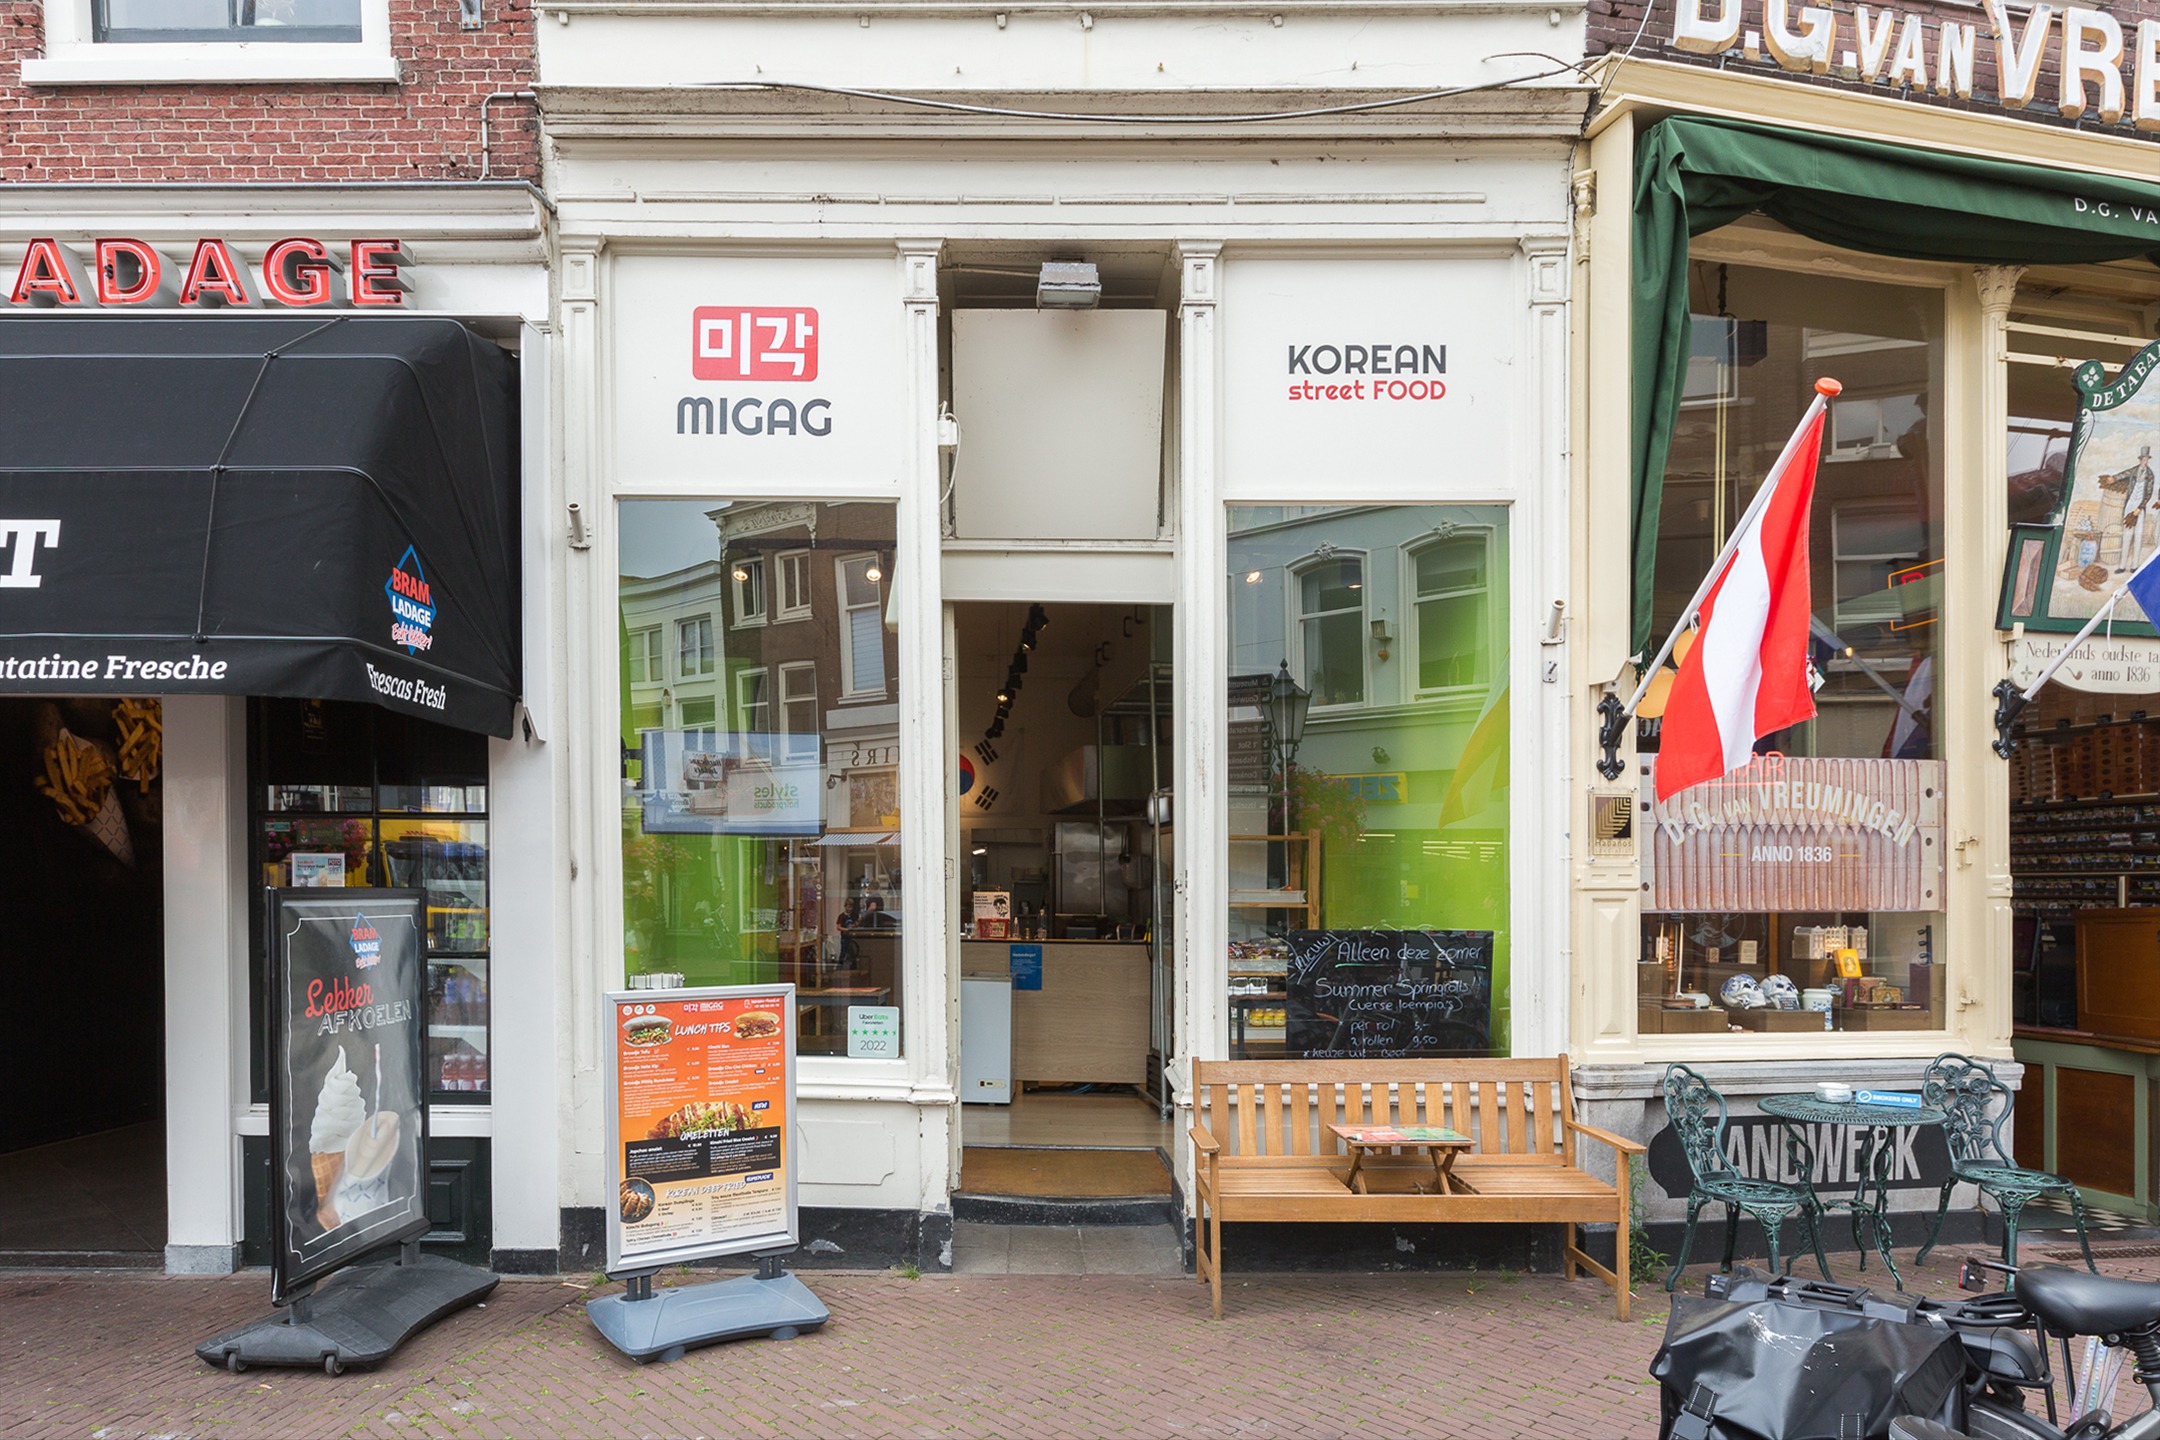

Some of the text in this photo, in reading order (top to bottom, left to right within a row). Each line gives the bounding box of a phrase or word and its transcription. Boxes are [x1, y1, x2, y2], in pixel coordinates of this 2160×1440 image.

[699, 312, 814, 376] 미각
[1288, 344, 1447, 375] KOREAN
[1288, 379, 1447, 401] street FOOD
[2092, 391, 2114, 408] DE
[676, 396, 832, 437] MIGAG
[392, 567, 431, 606] BRAM
[392, 594, 432, 628] LADAGE
[2102, 644, 2142, 662] oudste
[0, 653, 228, 681] tatine Fresche
[2091, 666, 2151, 683] anno 1836
[366, 662, 447, 710] Frescas Fresh
[1722, 796, 1752, 819] VAN
[1756, 780, 1917, 849] VREUMINGEN
[1595, 838, 1632, 847] Habanos
[1751, 846, 1833, 863] ANNO 1836
[351, 927, 379, 941] BRAM
[353, 942, 380, 953] LADAGE
[1337, 940, 1482, 963] Alleen deze zomer
[305, 975, 375, 1018] Lekker
[1314, 977, 1393, 999] Summer
[317, 999, 412, 1037] AFKOELEN
[1350, 1022, 1369, 1036] per
[1376, 1019, 1395, 1031] rol
[674, 1021, 731, 1036] LUNCH TIPS
[860, 1039, 887, 1051] 2022
[1362, 1035, 1393, 1046] rollen
[1872, 1094, 1901, 1103] SMOKERS
[679, 1128, 730, 1142] OMELETTEN
